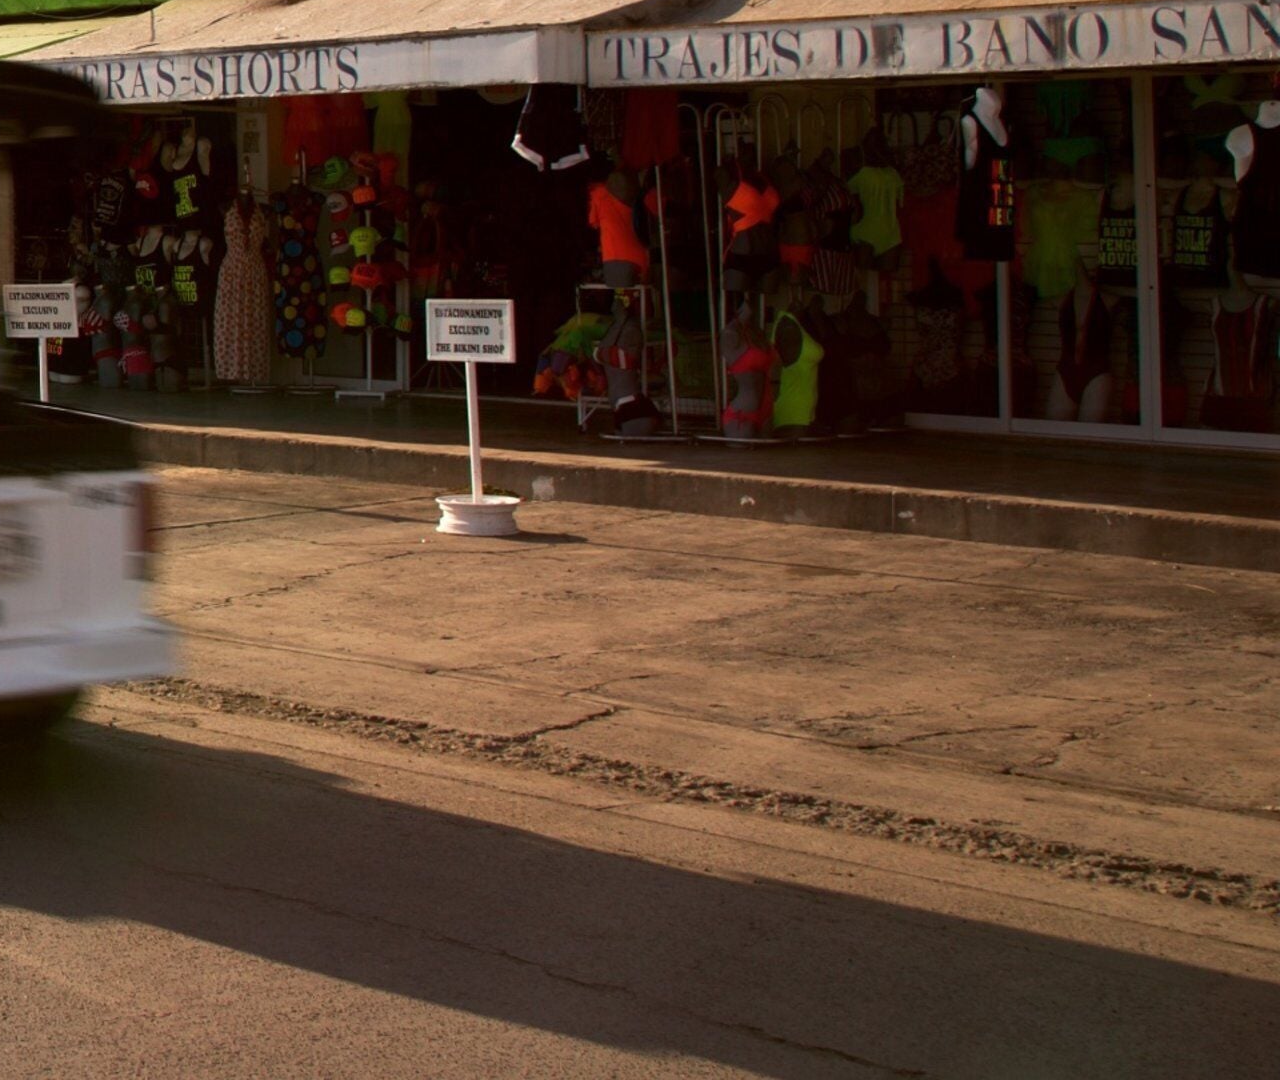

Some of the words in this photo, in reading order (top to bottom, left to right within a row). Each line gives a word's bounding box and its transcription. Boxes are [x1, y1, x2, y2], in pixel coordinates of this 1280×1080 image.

[604, 28, 801, 81] TRAJES
[834, 23, 906, 69] DE
[942, 11, 1109, 68] BANO
[57, 46, 358, 101] ERAS-SHORTS
[9, 292, 70, 301] ESTACIONAMIENTO
[22, 306, 58, 315] EXCLUSIVO
[435, 308, 503, 319] ESTACIONAMIENTO
[11, 322, 25, 330] THE
[28, 322, 51, 330] BIKINI
[53, 322, 72, 330] SHOP
[449, 325, 490, 335] EXCLUSIVO
[436, 343, 451, 353] THE
[454, 343, 480, 354] BIKINI
[483, 344, 504, 354] SHOP
